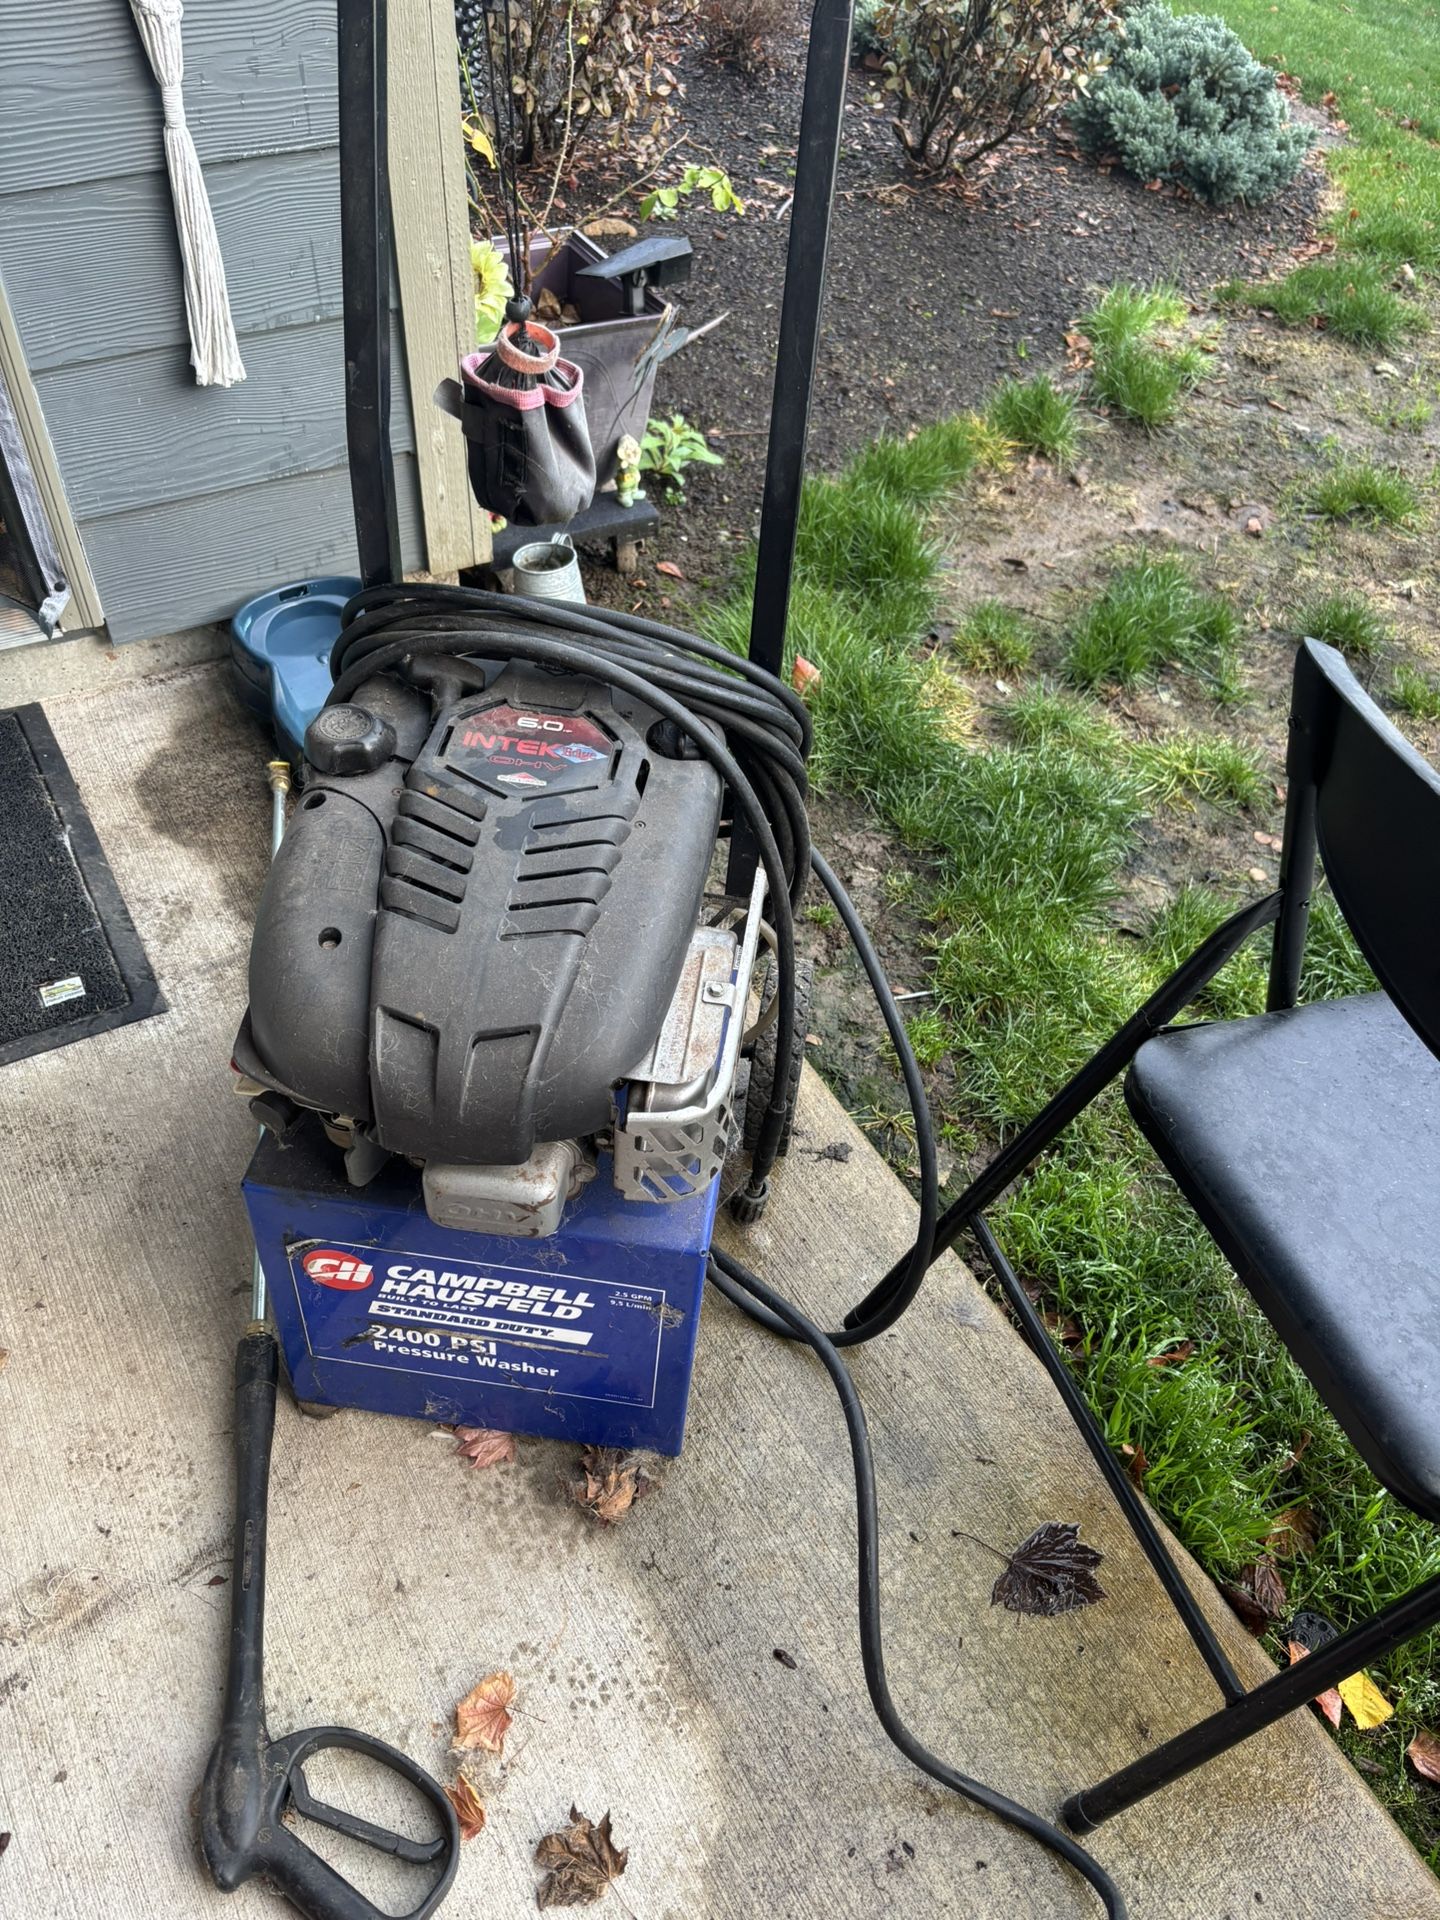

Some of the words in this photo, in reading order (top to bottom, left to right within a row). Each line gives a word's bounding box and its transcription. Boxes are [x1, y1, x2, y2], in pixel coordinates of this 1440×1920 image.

[517, 717, 564, 732] 6.0
[463, 731, 562, 760] INTEK
[487, 755, 568, 771] OHV
[380, 1279, 582, 1320] HAUSFELD
[387, 1265, 595, 1308] CAMPBELL
[378, 1293, 417, 1303] BUILT
[443, 1303, 477, 1312] LAST
[626, 1302, 652, 1310] L/min
[377, 1304, 490, 1327] STANDARD
[495, 1322, 554, 1337] DUTY
[371, 1325, 440, 1347] 2400
[450, 1336, 497, 1356] PSI
[373, 1340, 469, 1364] Pressure
[476, 1355, 560, 1377] Washer
